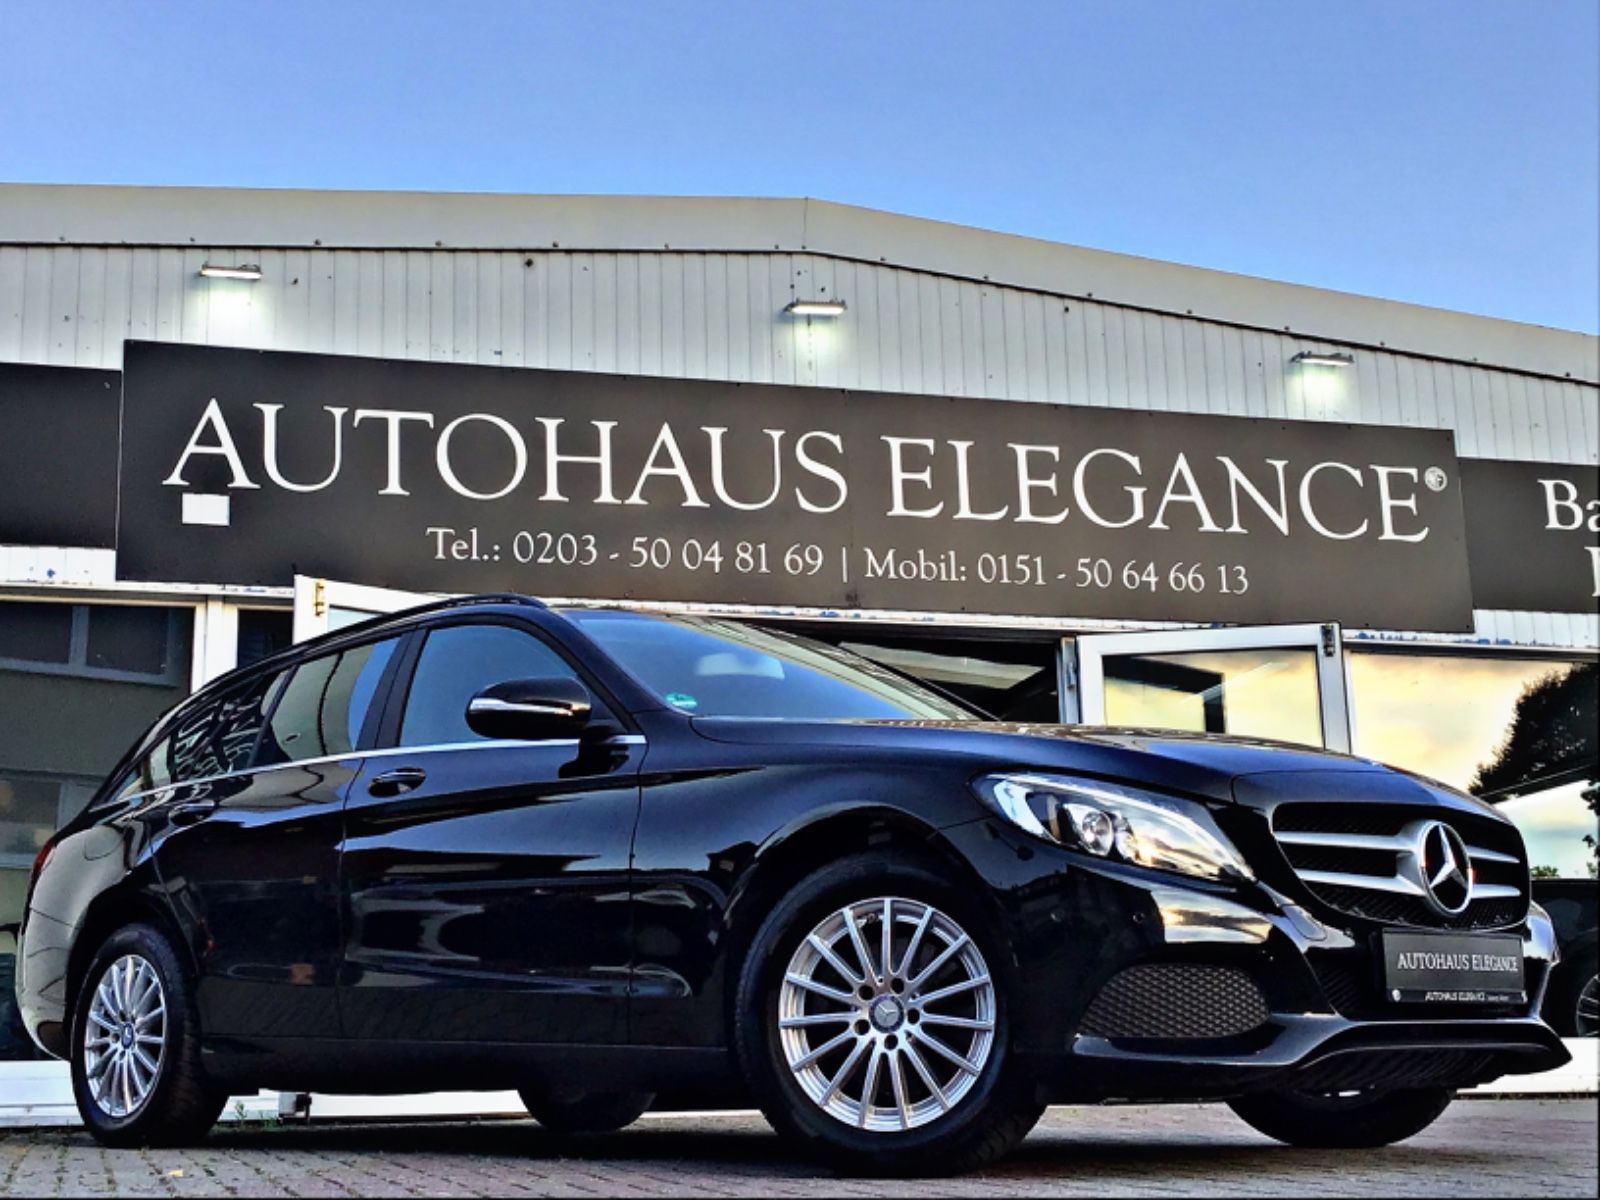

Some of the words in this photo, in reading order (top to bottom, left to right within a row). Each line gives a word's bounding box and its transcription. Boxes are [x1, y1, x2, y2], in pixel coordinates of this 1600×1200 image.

[161, 397, 848, 514] AUTOHAUS
[425, 527, 500, 562] Tel.:
[512, 530, 598, 566] 0203
[629, 536, 672, 570] 50
[681, 538, 724, 574] 04
[734, 540, 771, 574] 81
[783, 542, 825, 576] 69
[862, 546, 968, 582] Mobil:
[977, 552, 1047, 586] 0151
[1075, 556, 1113, 589] 50
[1121, 559, 1160, 593] 64
[1168, 561, 1206, 593] 66
[1217, 564, 1249, 595] 13
[1397, 952, 1469, 970] AUTOHAUS
[1472, 954, 1518, 971] ELEGANCE
